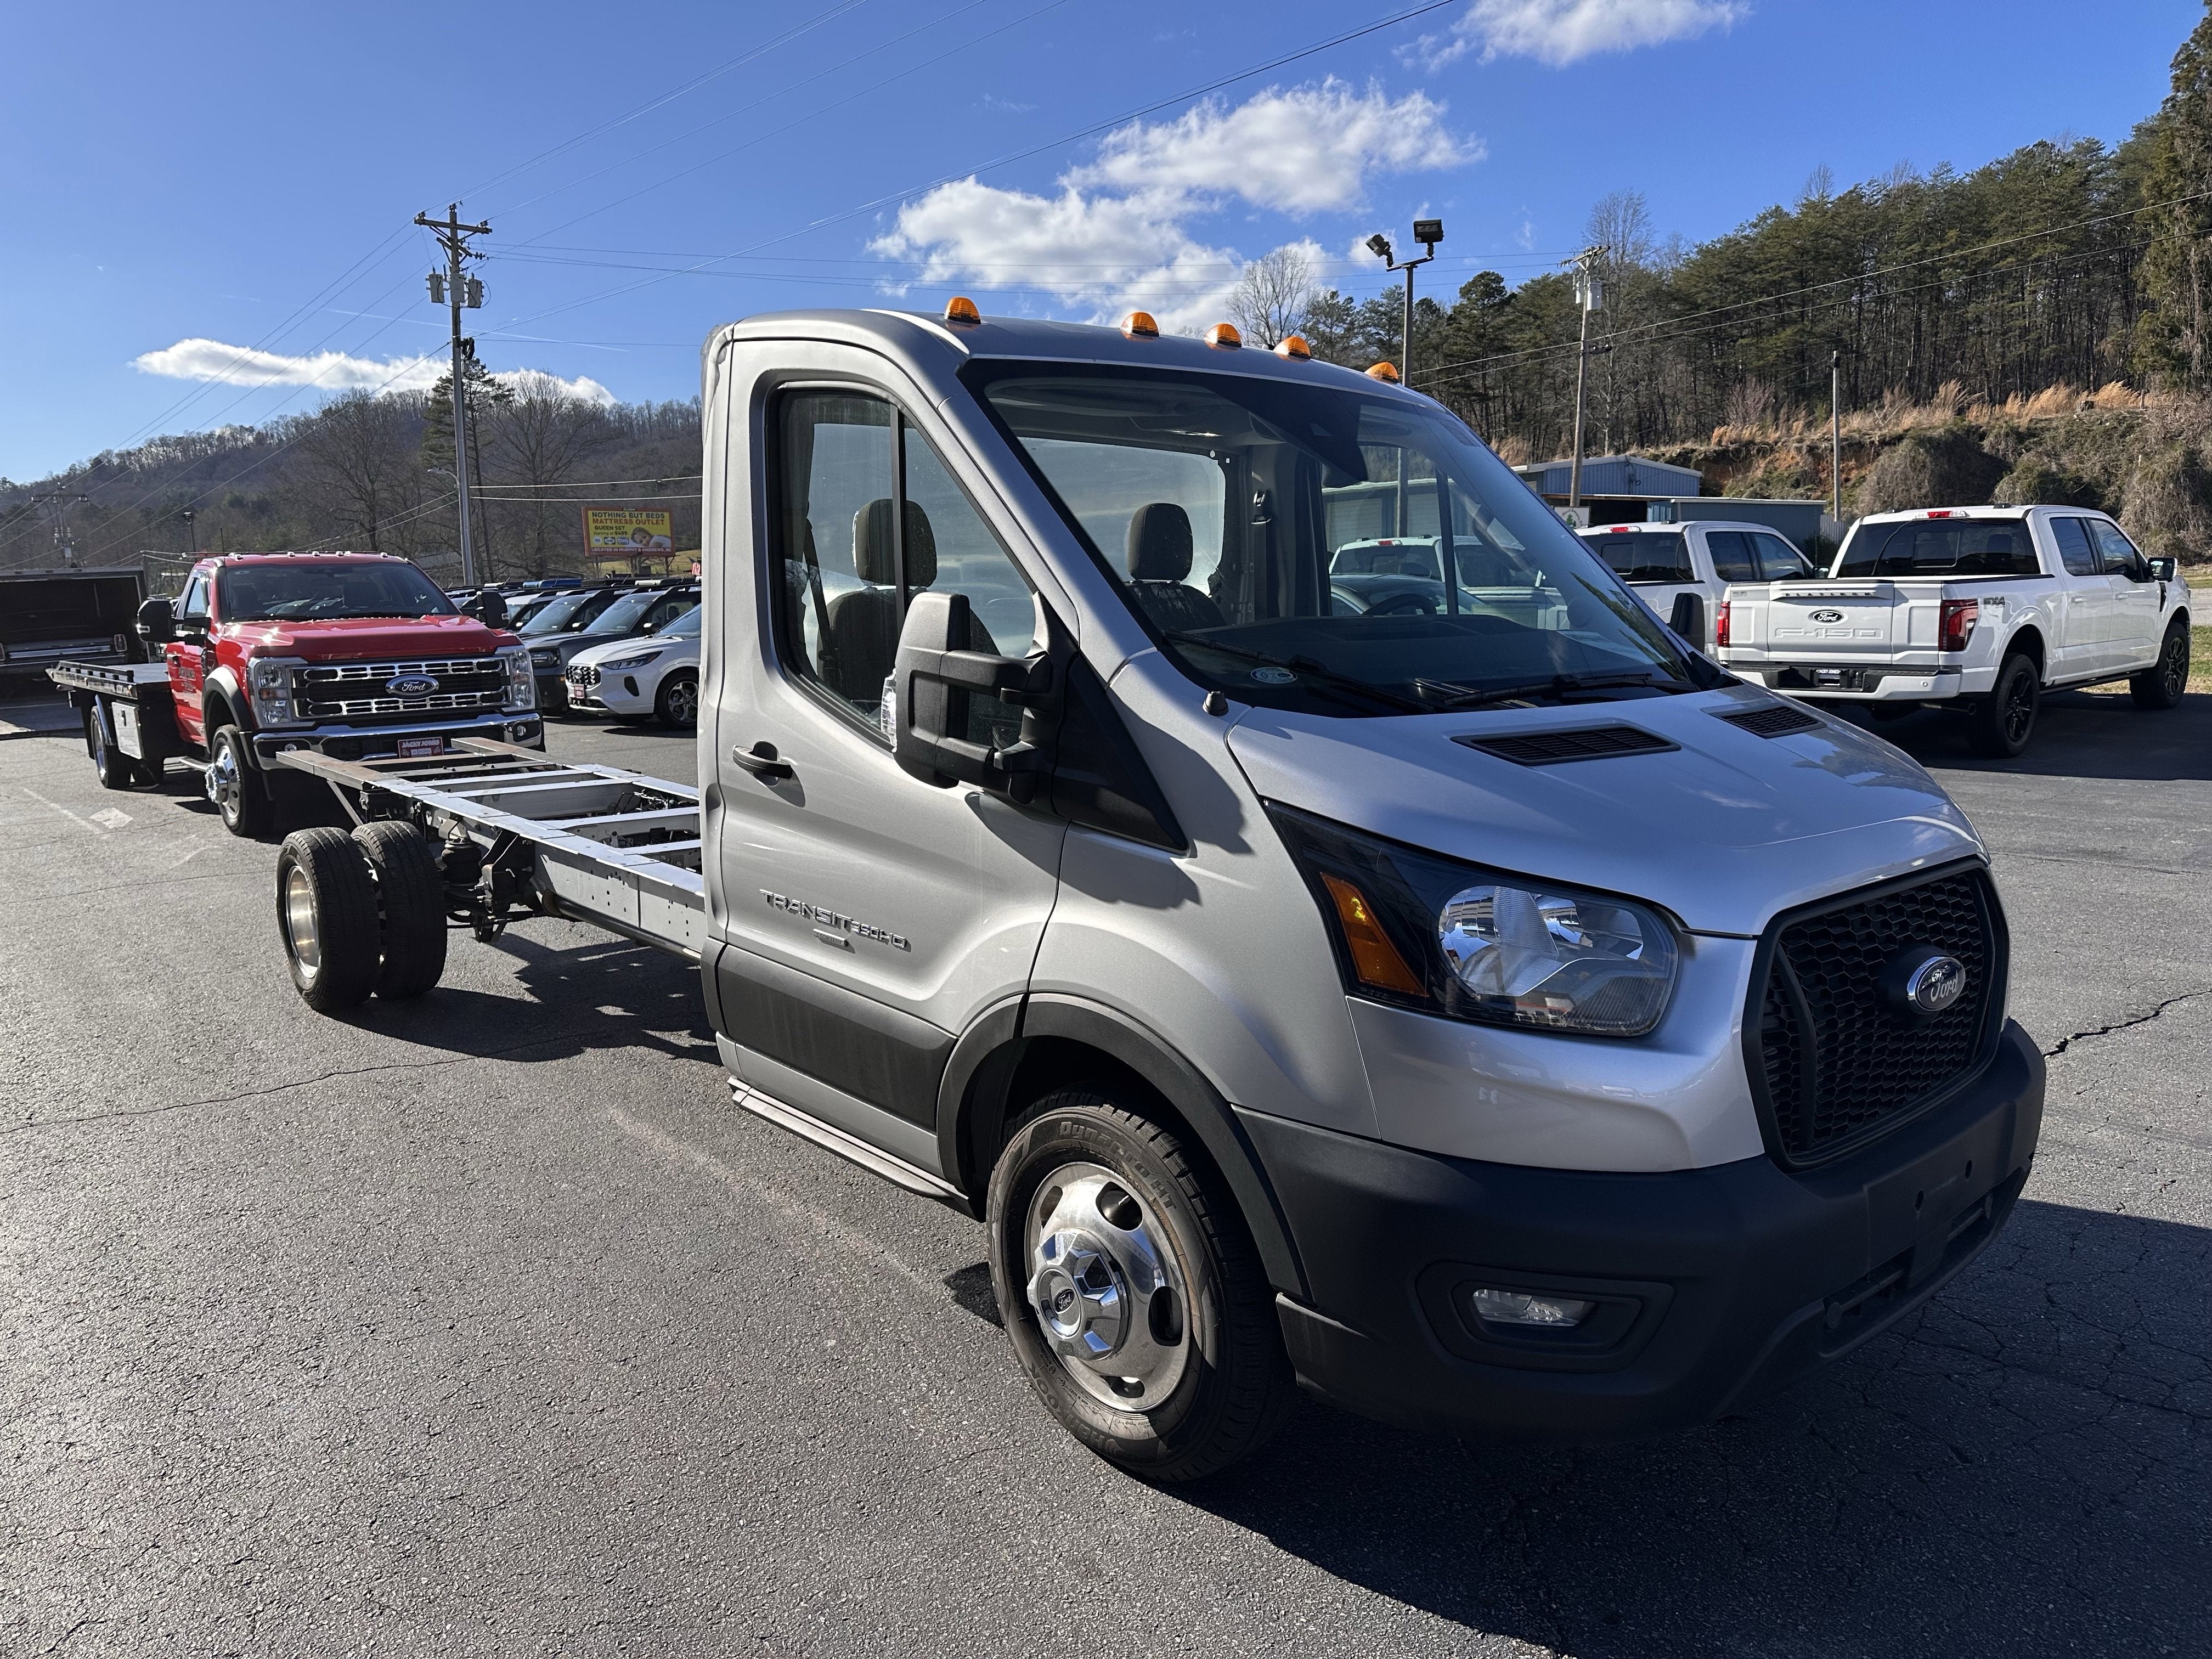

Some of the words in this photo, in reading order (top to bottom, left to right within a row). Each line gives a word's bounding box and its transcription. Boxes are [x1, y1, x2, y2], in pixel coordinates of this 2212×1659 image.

[1983, 596, 2005, 606] FX4
[1818, 612, 1838, 621] Ford
[1775, 628, 1883, 639] F-150
[402, 681, 426, 691] Ford
[759, 889, 851, 929] TRANSIT
[1930, 965, 1959, 1002] Ford
[1058, 1294, 1071, 1310] Ford
